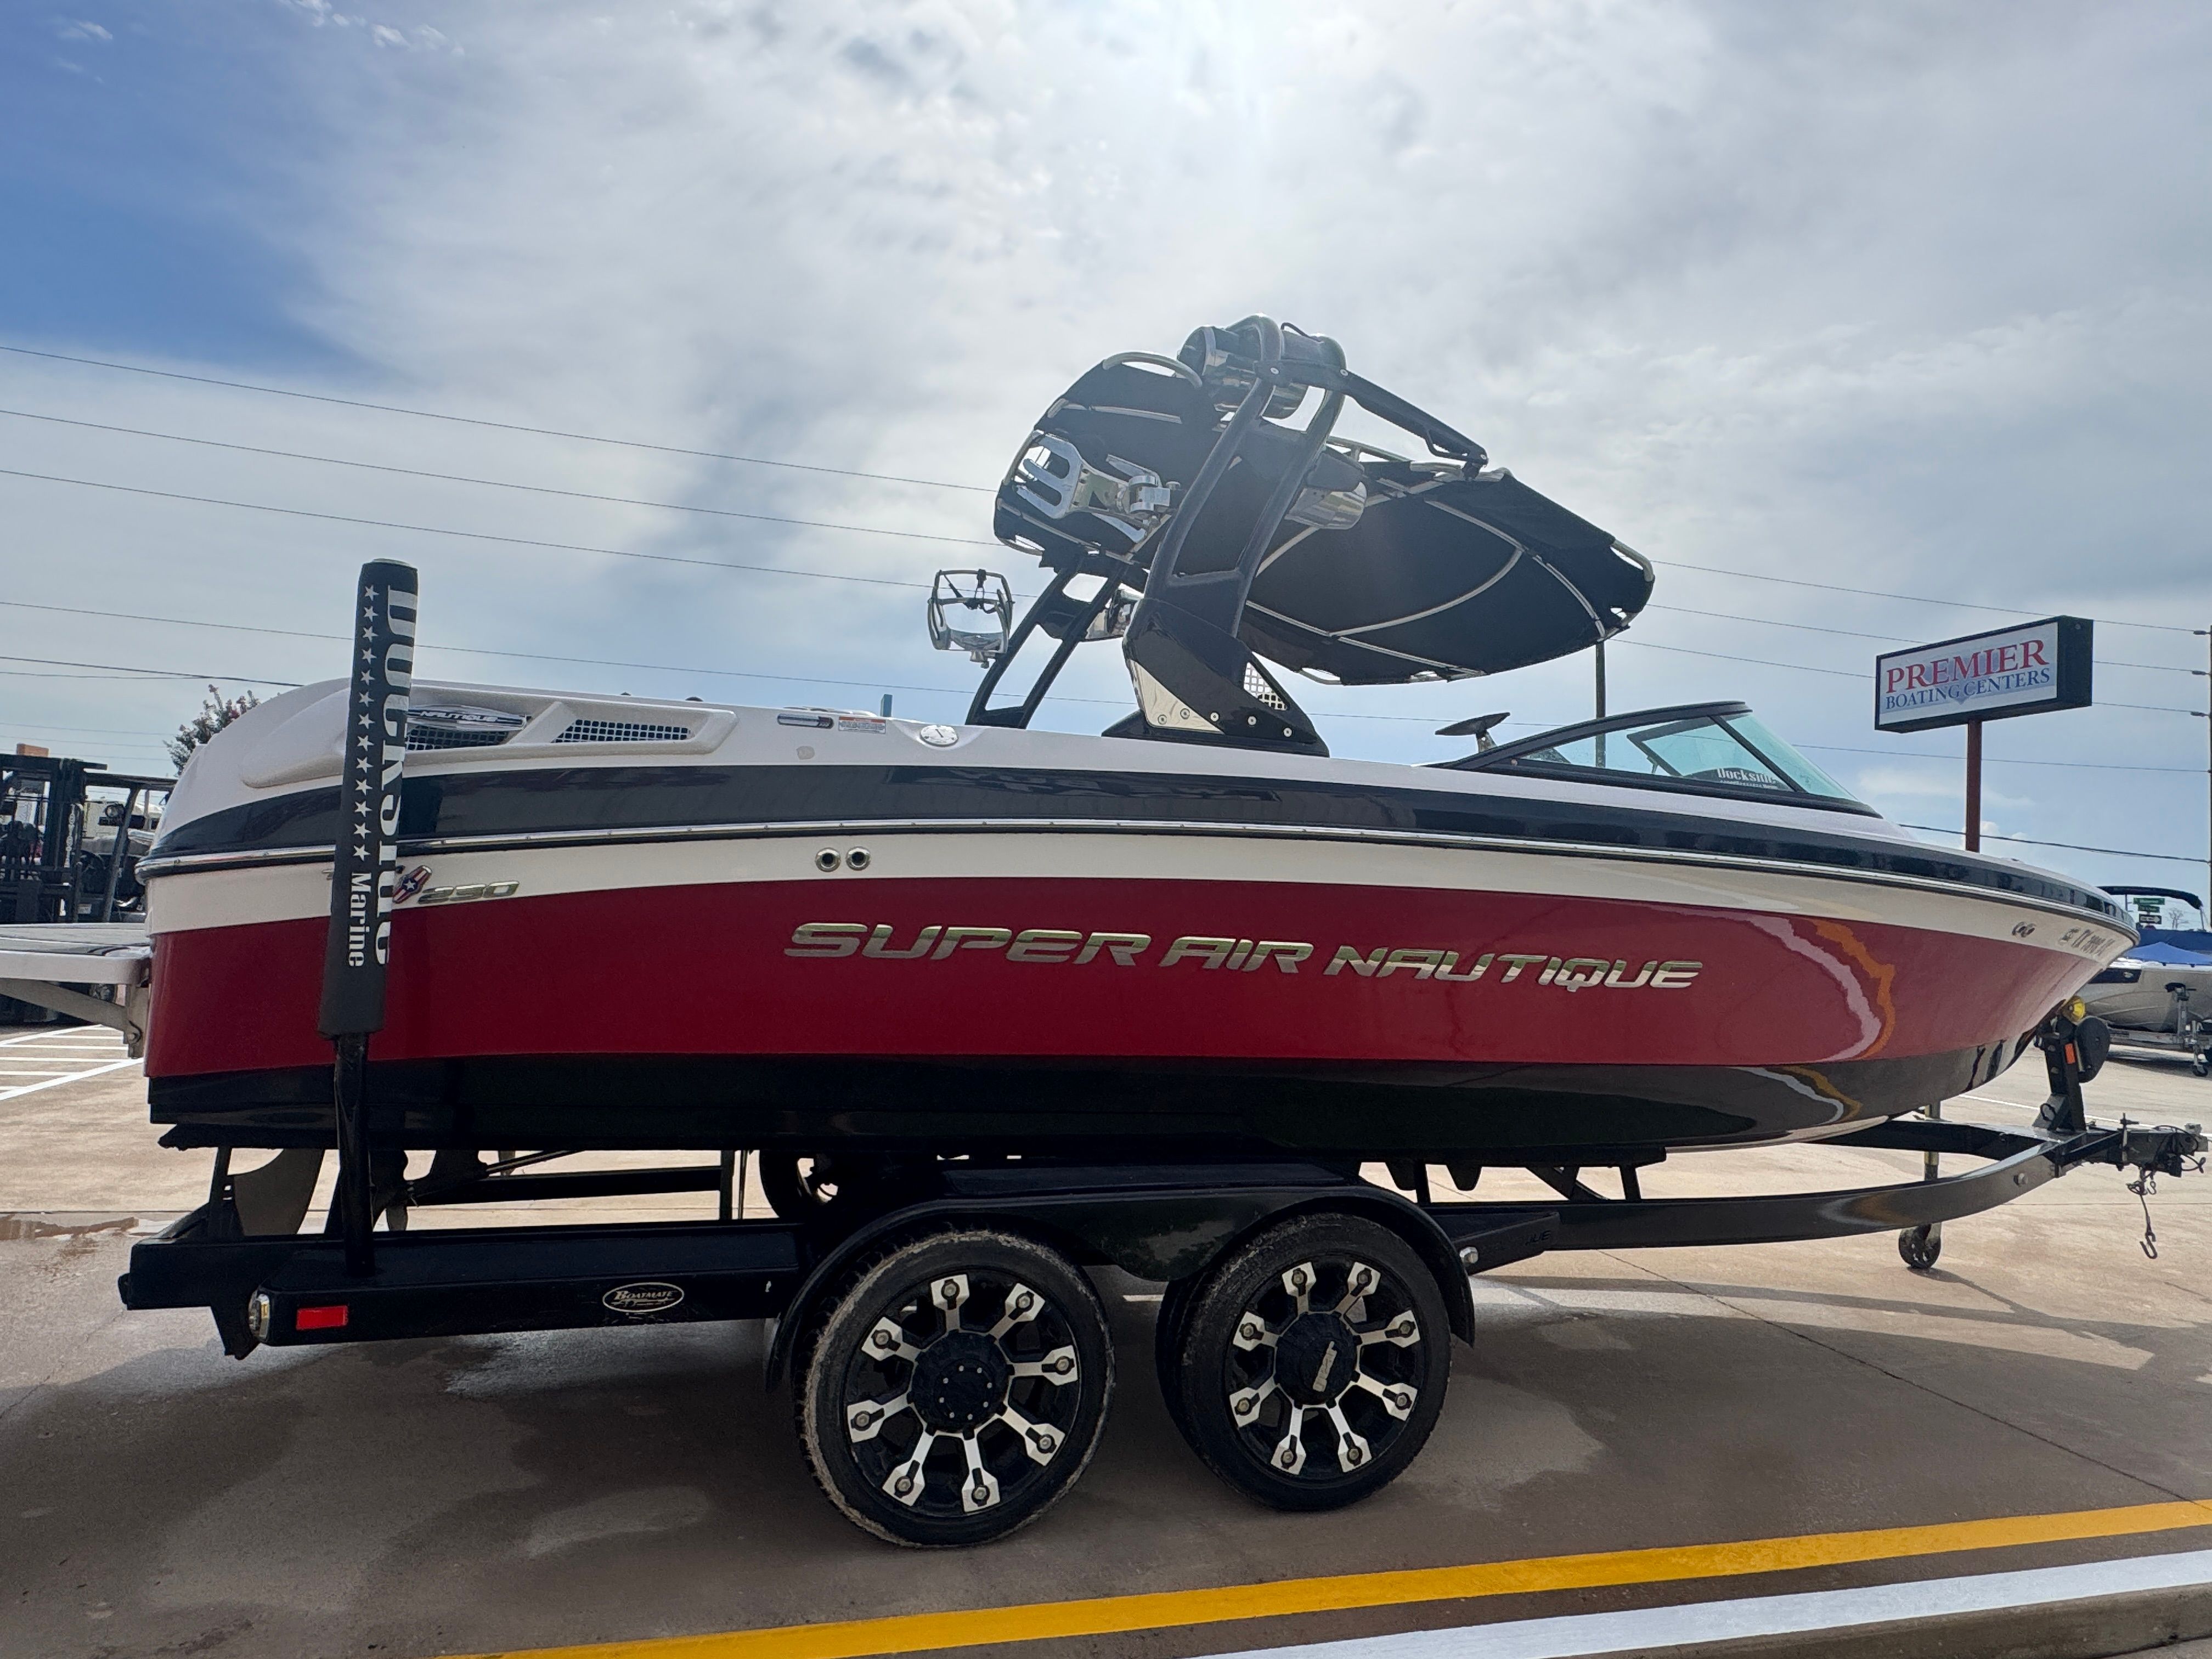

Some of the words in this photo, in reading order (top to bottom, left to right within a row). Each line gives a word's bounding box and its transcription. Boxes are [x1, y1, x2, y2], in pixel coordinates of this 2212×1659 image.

[1886, 640, 2050, 693] PREMIER
[1886, 685, 1960, 709] BOATING
[1964, 668, 2050, 697] CENTERS
[420, 711, 498, 723] NAUTIQUE
[348, 873, 372, 967] Marine
[784, 923, 1152, 966] SUPER
[1159, 936, 1314, 973] AIR
[1323, 945, 1703, 992] NAUTIQUE
